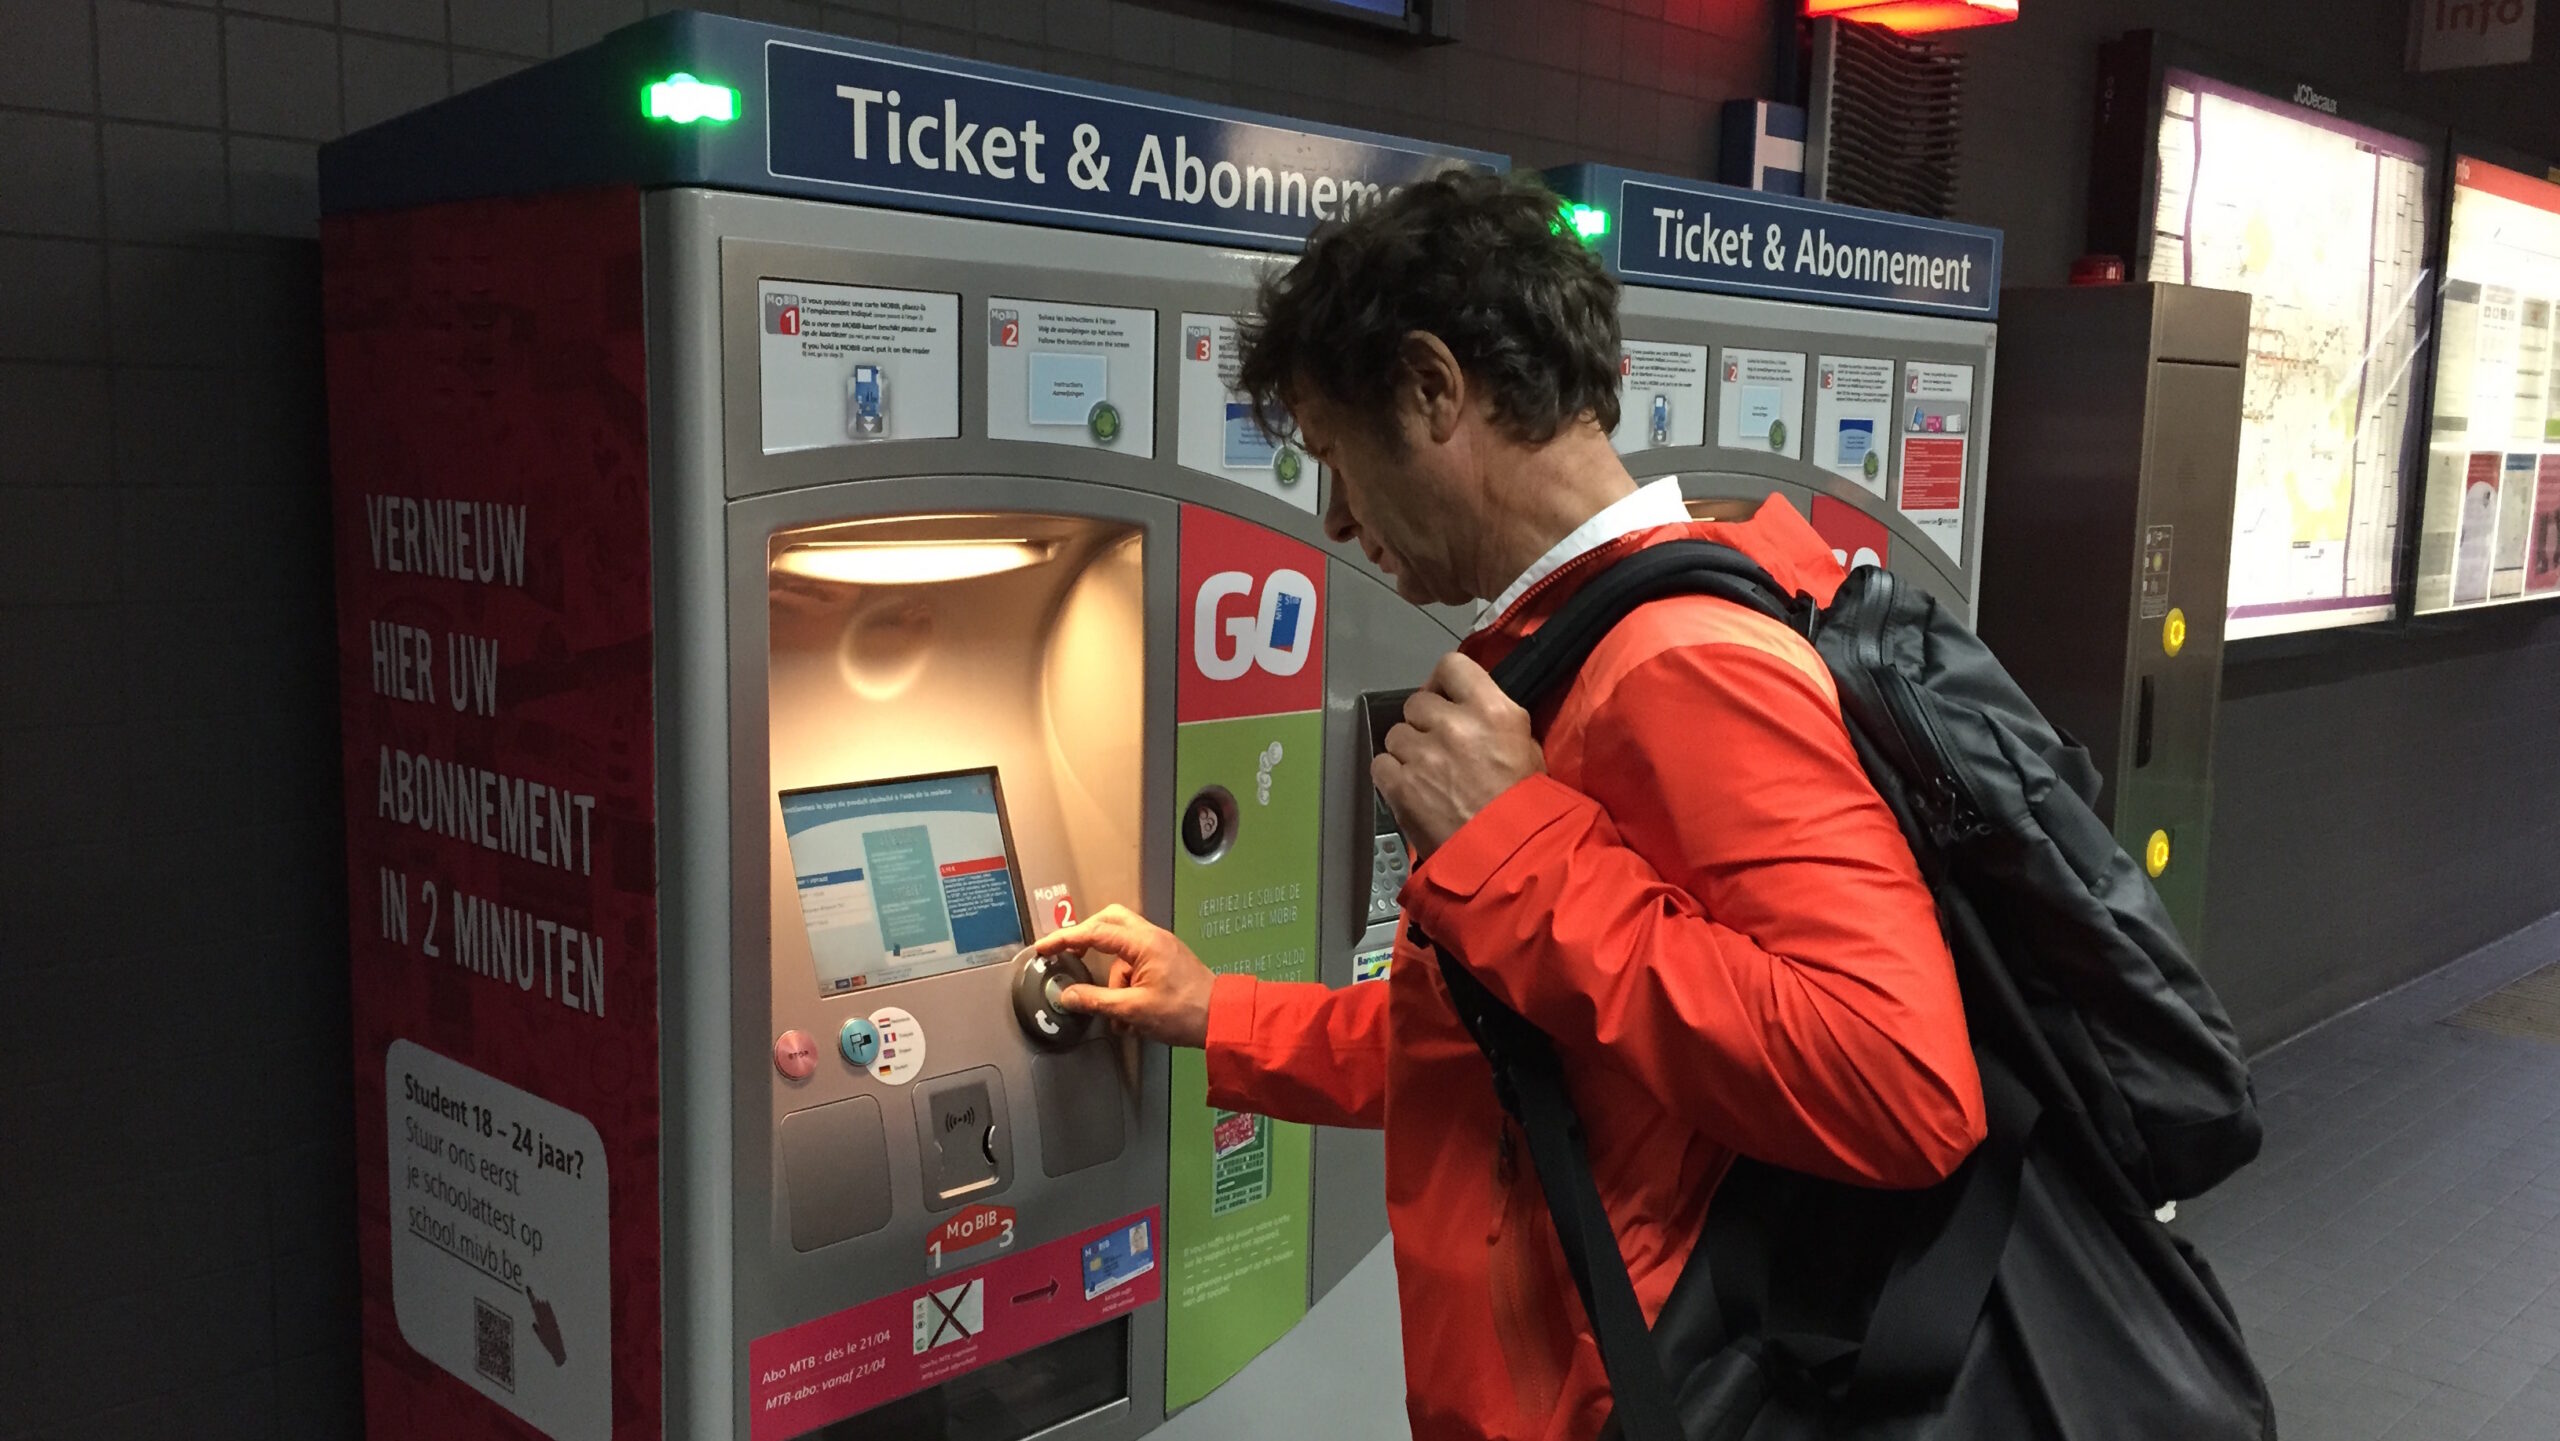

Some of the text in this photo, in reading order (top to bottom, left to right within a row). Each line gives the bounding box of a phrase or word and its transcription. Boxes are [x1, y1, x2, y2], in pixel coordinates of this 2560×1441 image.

[2293, 83, 2338, 114] JCDecaux
[836, 85, 1046, 183] Ticket
[1068, 123, 1110, 192] &
[2455, 158, 2471, 182] nfo
[1653, 207, 1972, 293] Ticket & Abonnement
[766, 293, 799, 306] MOBIB
[785, 310, 797, 333] 1
[1006, 324, 1018, 346] 2
[807, 343, 820, 351] you
[876, 346, 887, 354] put
[1200, 339, 1210, 360] 3
[1623, 358, 1630, 375] 1
[1730, 365, 1737, 382] 2
[1826, 373, 1833, 389] 3
[1911, 377, 1918, 393] 4
[365, 493, 527, 588] VERNIEUW
[1194, 568, 1318, 681] GO
[370, 619, 499, 718] HIER UW
[378, 744, 596, 877] ABONNEMENT
[1033, 883, 1069, 901] MOBIB
[1242, 892, 1254, 910] LE
[1257, 886, 1285, 906] SOLDE
[1289, 883, 1300, 899] DE
[1057, 900, 1076, 928] 2
[1201, 905, 1298, 939] VOTRE CARTE MOBIB
[380, 866, 606, 1019] IN 2 MINUTEN
[1255, 955, 1272, 972] HET
[1276, 946, 1305, 966] SALDO
[403, 1072, 469, 1129] Student
[472, 1103, 493, 1139] 18
[511, 1121, 533, 1157] 24
[537, 1132, 584, 1180] jaar?
[404, 1115, 521, 1196] Stuur ons eerst
[406, 1156, 543, 1258] je schoolattest op
[946, 1210, 998, 1240] MOBIB
[407, 1203, 523, 1288] school.mivb.be
[929, 1218, 1014, 1269] 1 3
[761, 1367, 787, 1386] Abo
[789, 1356, 816, 1376] MTB
[824, 1346, 845, 1363] dès
[847, 1342, 857, 1355] le
[859, 1329, 891, 1351] 21/04
[765, 1356, 887, 1412] MTB-abo: vanaf 21/04
